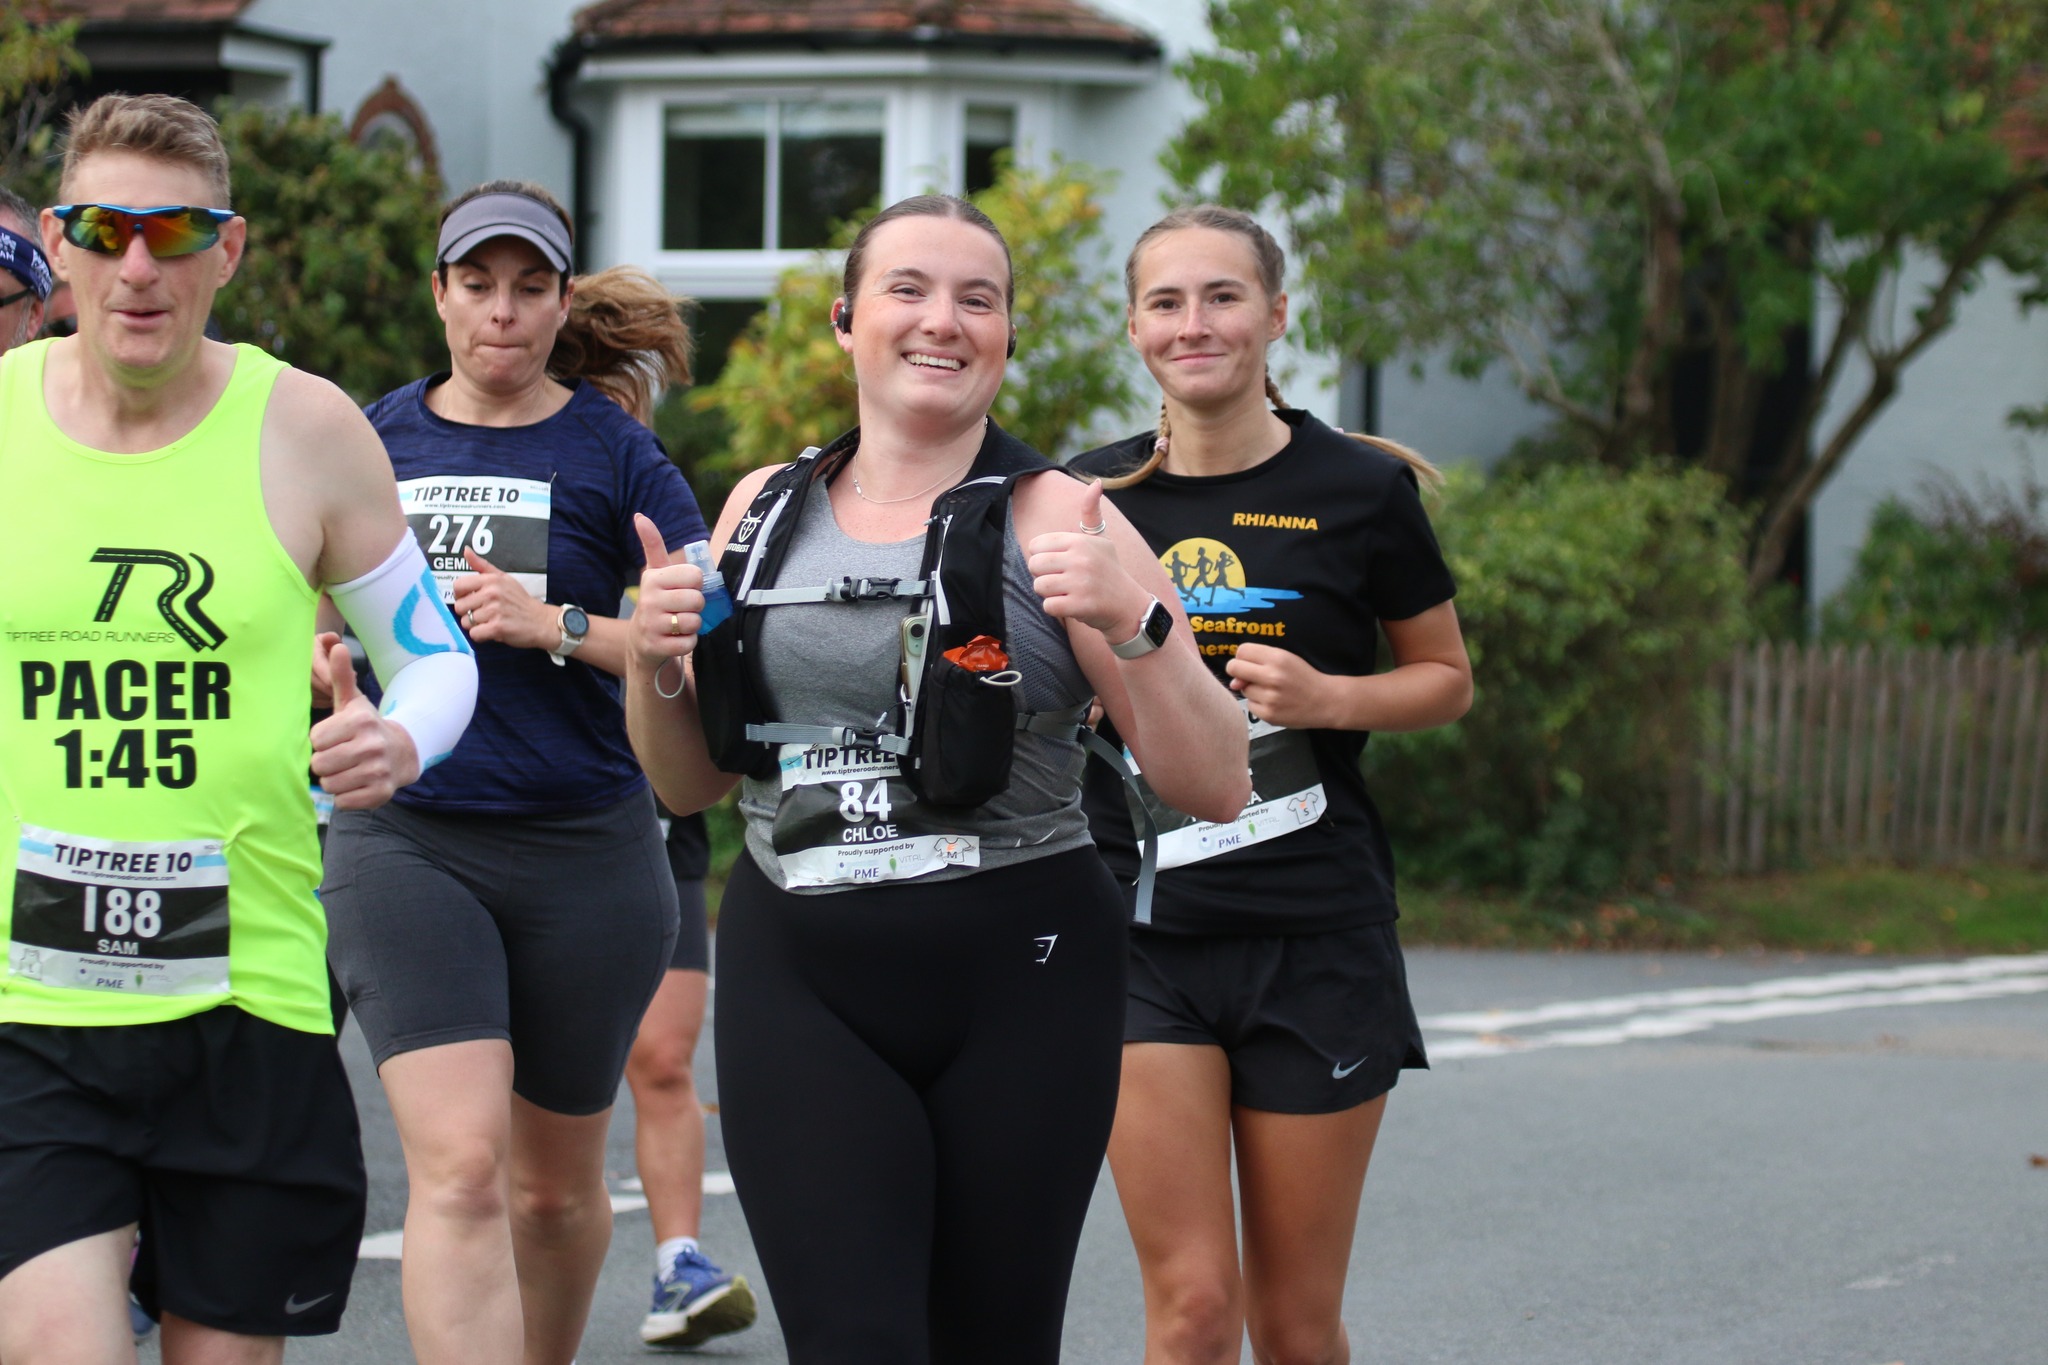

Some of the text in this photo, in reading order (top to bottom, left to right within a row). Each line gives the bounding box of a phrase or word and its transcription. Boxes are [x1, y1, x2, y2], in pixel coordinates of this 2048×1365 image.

[414, 486, 493, 502] TIPTREE
[498, 488, 520, 503] 10
[1232, 512, 1318, 530] RHIANNA
[427, 514, 494, 555] 276
[1189, 615, 1286, 637] Seafront
[6, 631, 176, 643] TIPTREE ROAD RUNNERS
[20, 659, 232, 722] PACER
[54, 728, 198, 790] 1:45
[803, 747, 896, 769] TIPTREE
[840, 779, 892, 823] 84
[1303, 808, 1310, 816] S
[842, 824, 899, 843] CHLOE
[1218, 834, 1242, 848] PME
[55, 843, 193, 873] TIPTREE 10
[838, 843, 915, 857] Proudly supported by
[947, 851, 958, 859] M
[854, 867, 880, 879] PME
[83, 886, 162, 938] 188
[97, 939, 139, 955] SAM
[79, 957, 111, 967] Proudly
[111, 960, 153, 969] supported
[96, 978, 124, 989] PME
